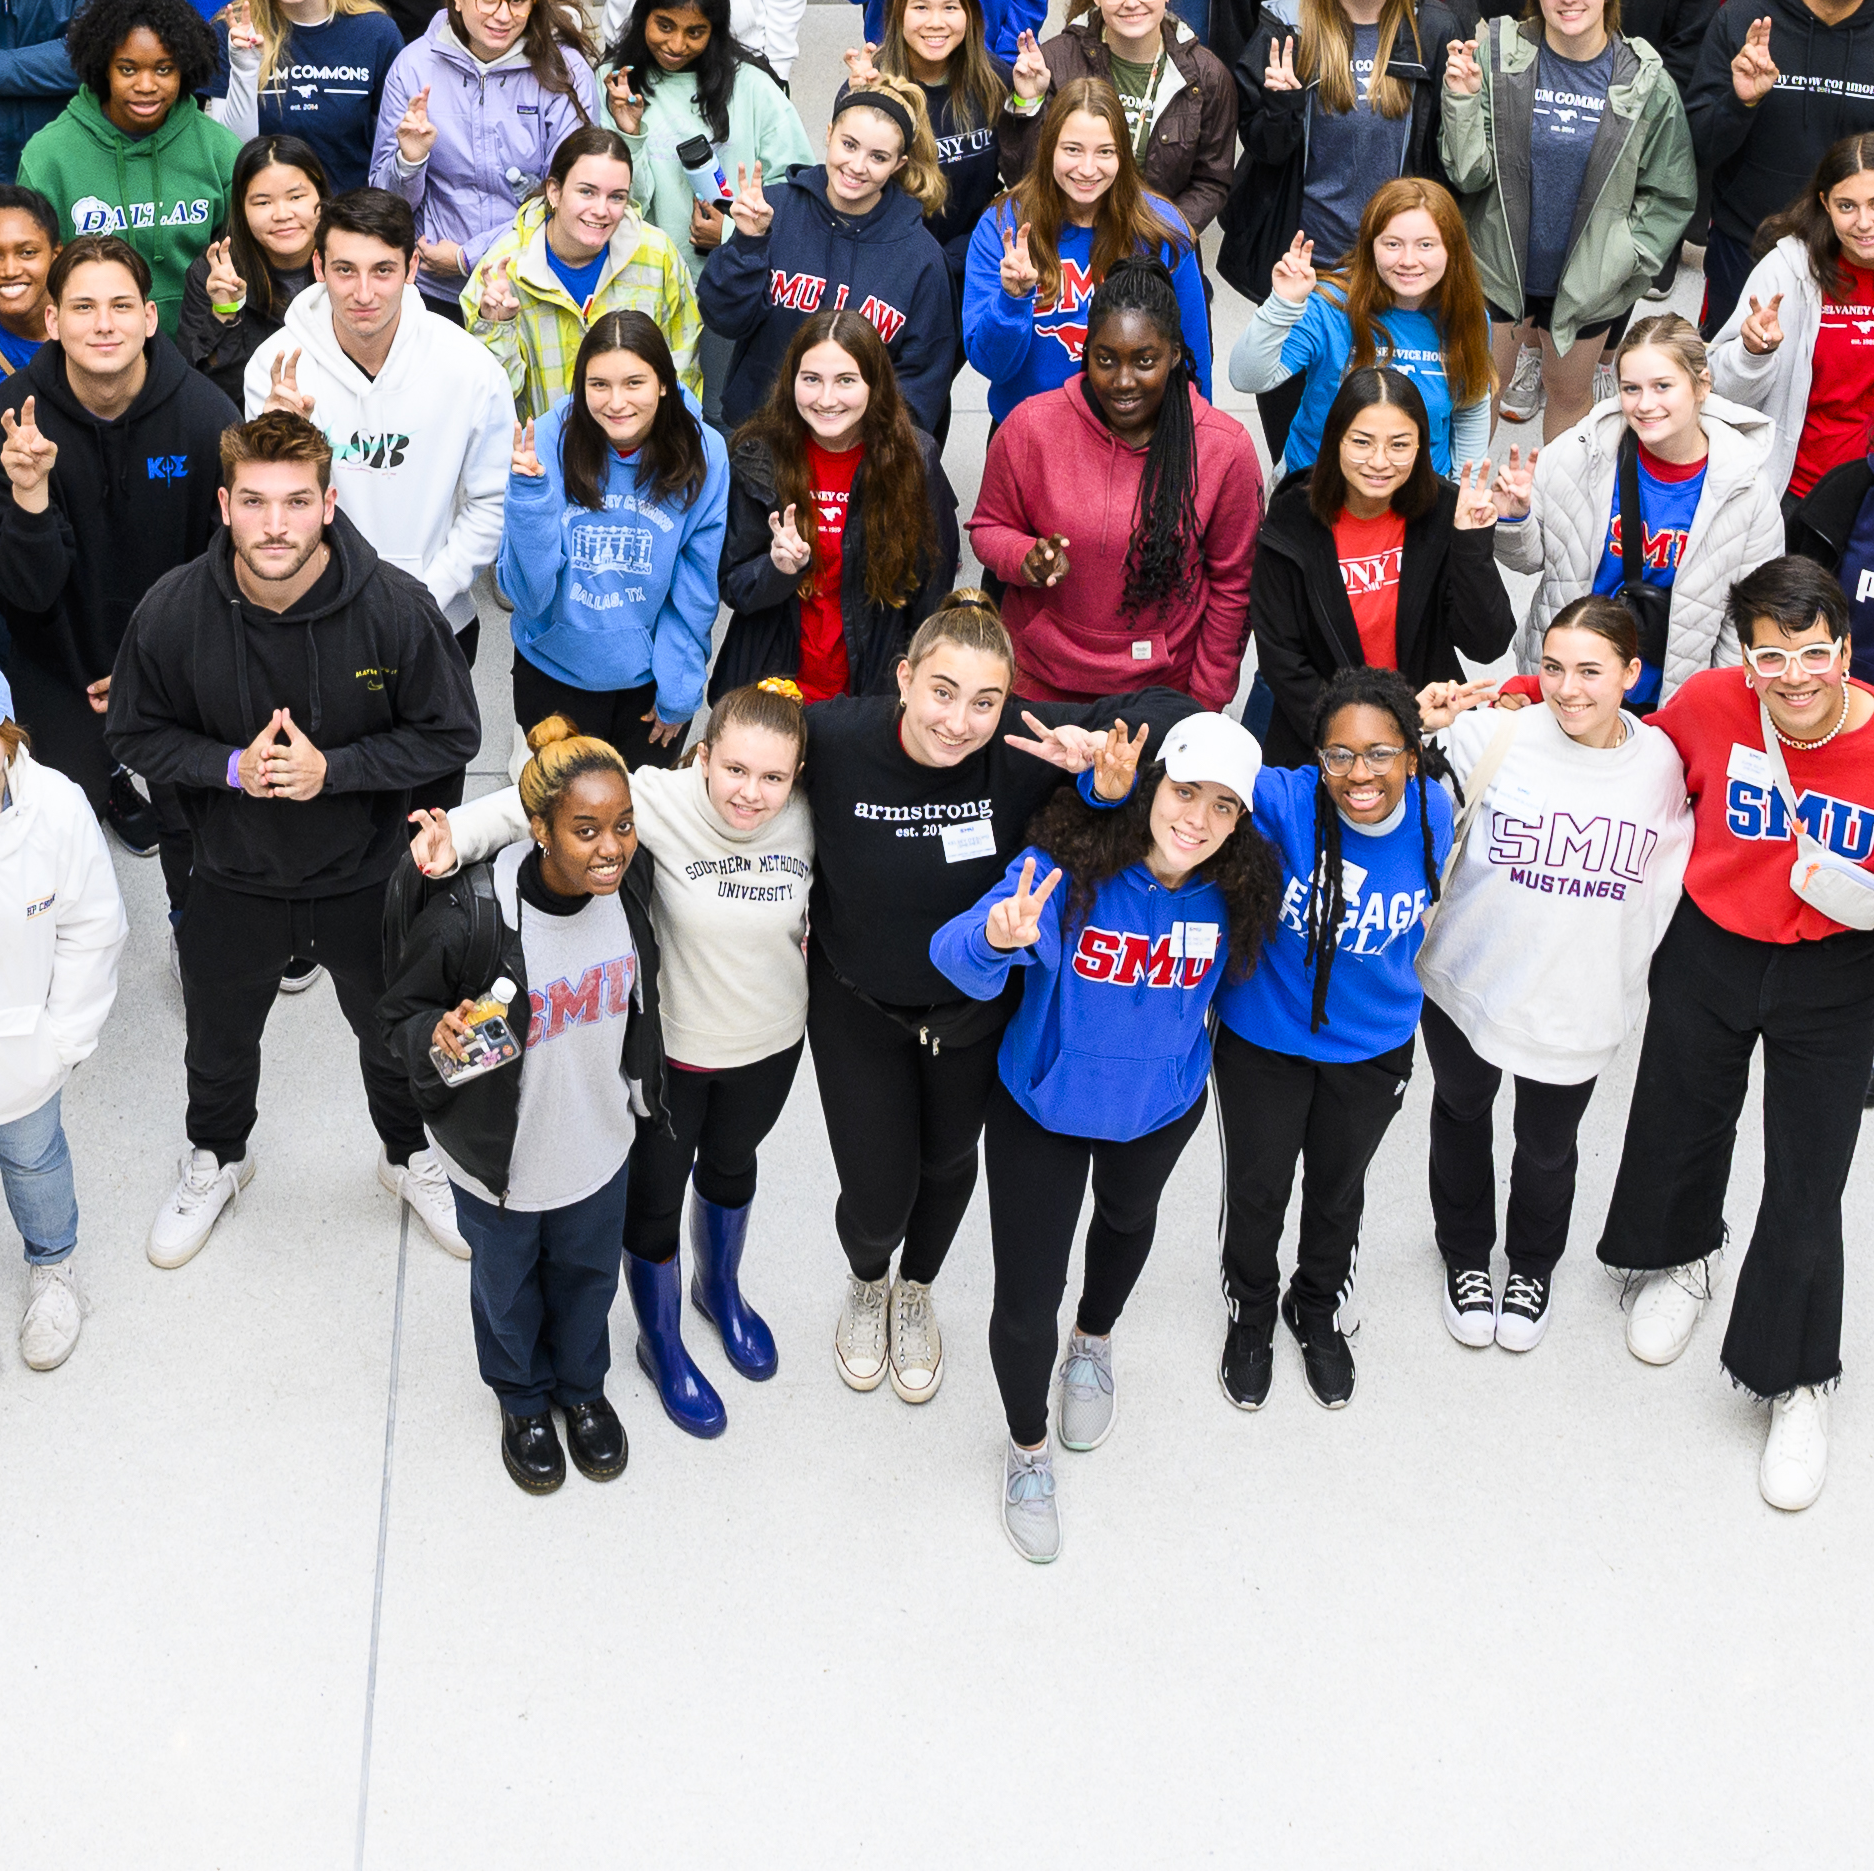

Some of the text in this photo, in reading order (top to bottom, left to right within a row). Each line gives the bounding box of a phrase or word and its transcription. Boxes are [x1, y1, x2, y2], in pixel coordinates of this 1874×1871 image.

[290, 65, 370, 82] COMMONS
[769, 269, 827, 313] MU
[569, 582, 646, 611] DALLAS, TX
[854, 798, 994, 821] armstrong
[895, 823, 952, 838] est. 201
[1488, 811, 1659, 885] SMU
[685, 854, 809, 881] SOUTHERN METHODIST
[717, 881, 794, 902] UNIVERSITY
[1509, 866, 1628, 902] MUSTANGS
